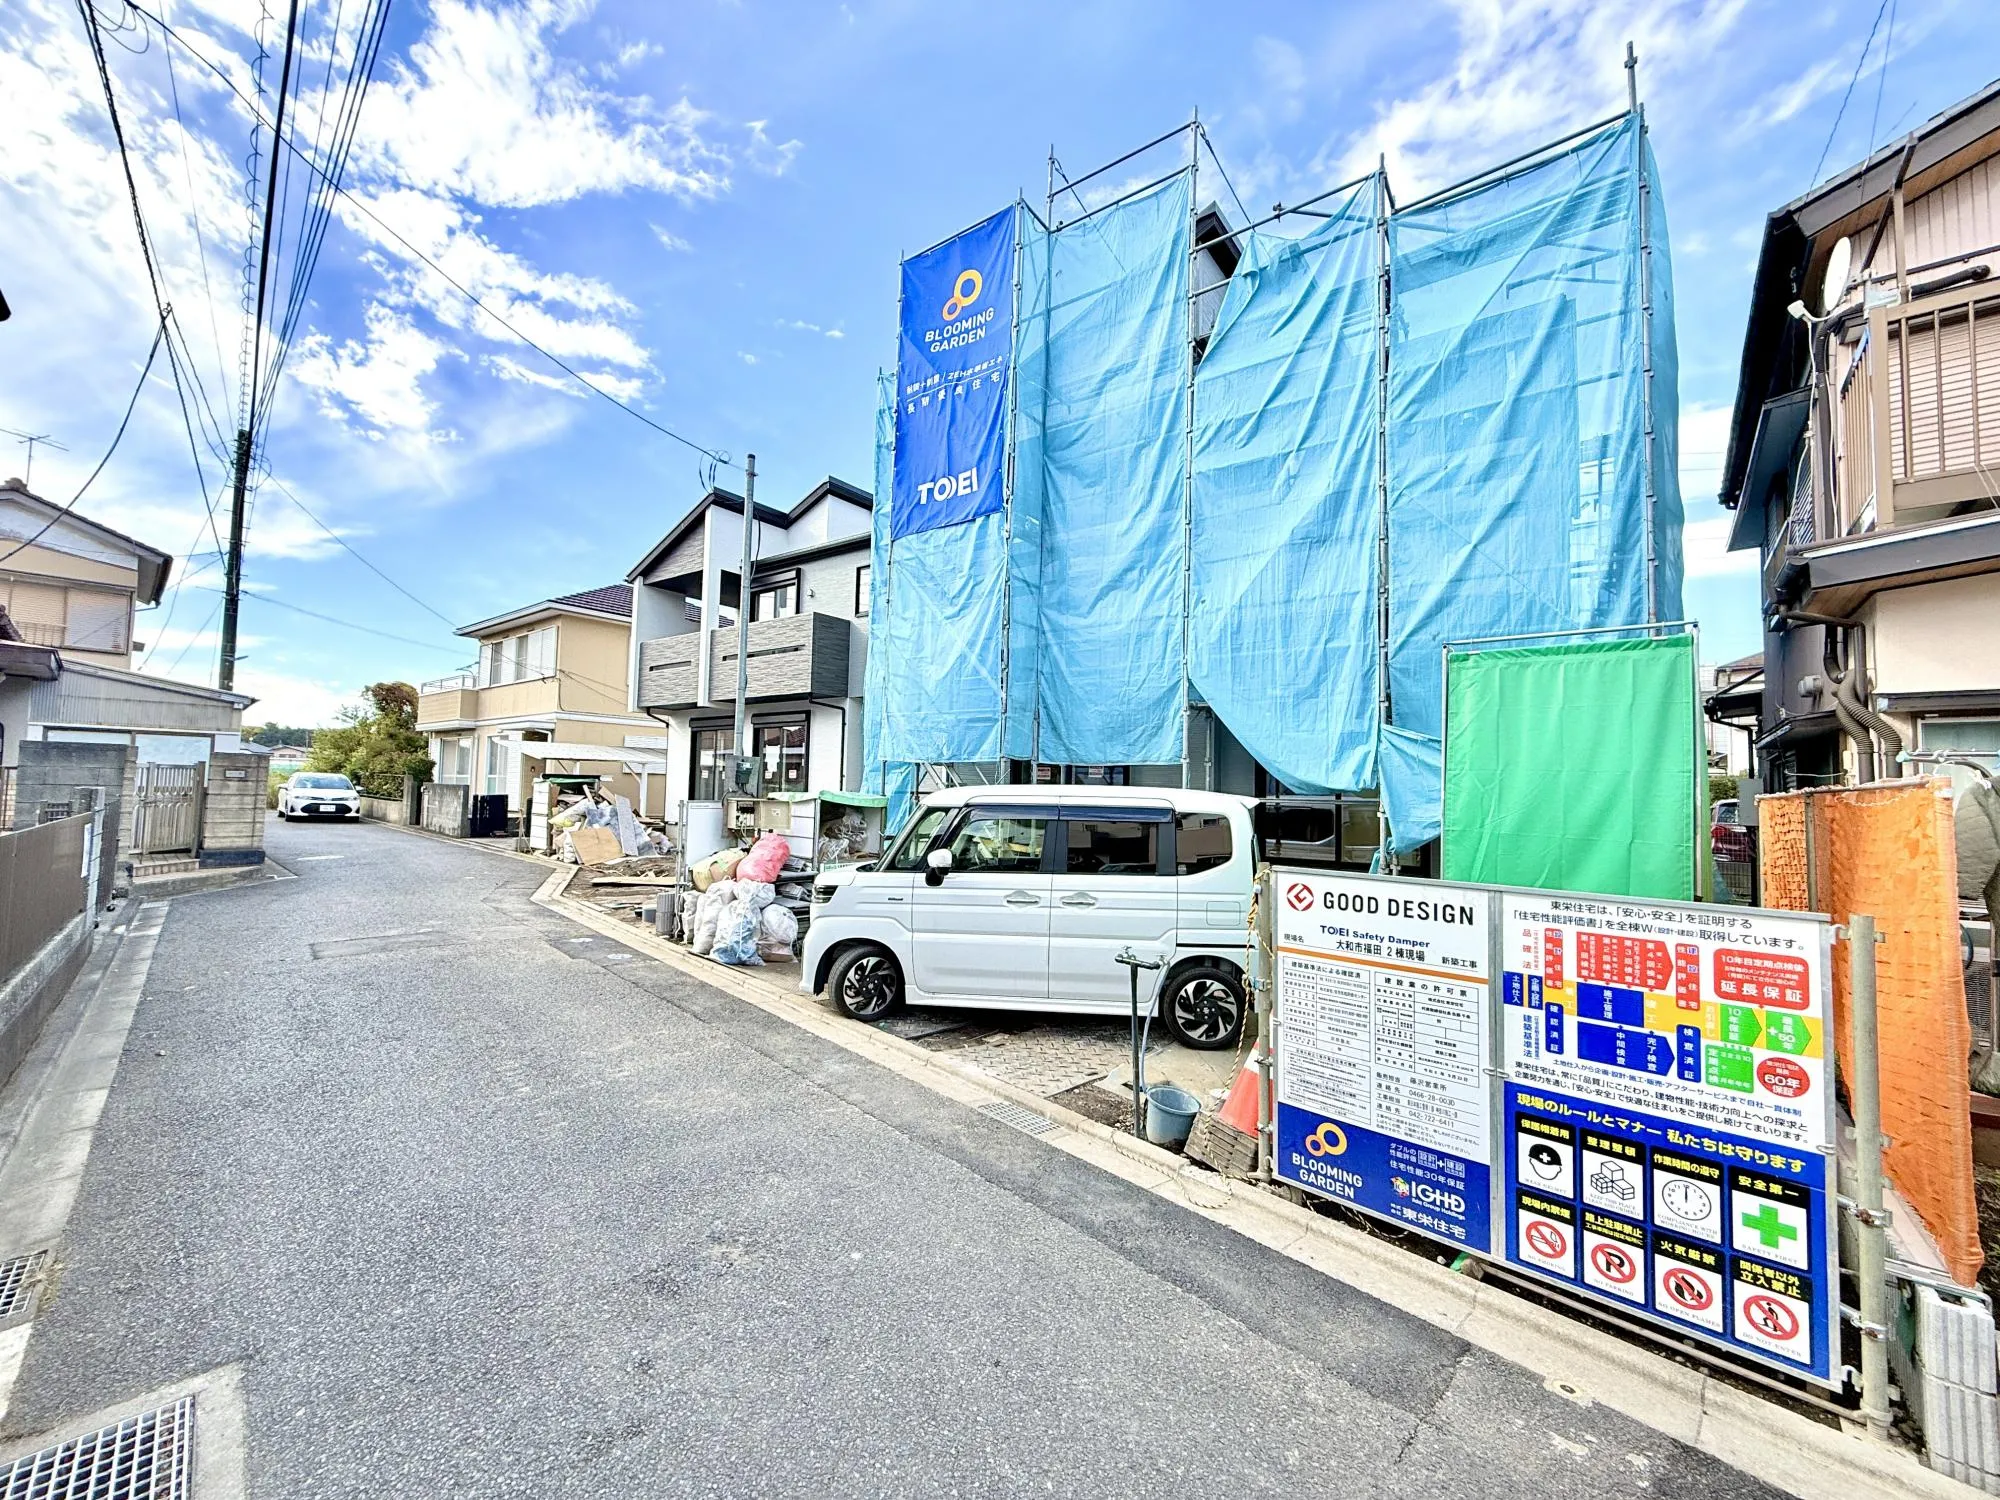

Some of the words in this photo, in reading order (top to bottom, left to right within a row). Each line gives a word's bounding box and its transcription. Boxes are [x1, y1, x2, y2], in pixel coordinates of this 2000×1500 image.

[925, 308, 994, 342] BLOOMING
[930, 328, 986, 352] GARDEN
[1323, 891, 1378, 914] GOOD
[1388, 898, 1473, 925] DESIGN
[1336, 938, 1381, 955] 大和市福田
[1441, 956, 1477, 969] 新築工事
[1352, 930, 1384, 943] Safety
[1388, 935, 1430, 949] Damper
[1522, 928, 1531, 969] 品確法
[1512, 974, 1520, 1003] 土地仕入
[1602, 988, 1612, 1019] 施工管理
[1720, 979, 1803, 1003] 延長保証
[1550, 1004, 1558, 1052] 確認済証
[1616, 1031, 1625, 1065] 中間検査
[1646, 1036, 1656, 1072] 完了検査
[1683, 1028, 1694, 1079] 検査済証
[1764, 1073, 1800, 1089] 60年
[1390, 1141, 1416, 1156] ダブルの
[1516, 1092, 1661, 1139] 現場のルールとマナー
[1667, 1128, 1806, 1175] 私たちは守ります
[1292, 1152, 1362, 1188] BLOOMING
[1299, 1167, 1353, 1199] GARDEN
[1390, 1159, 1464, 1191] 住宅性能30年保証
[1738, 1174, 1798, 1200] 安全第一
[1402, 1205, 1465, 1240] 東栄住宅
[1739, 1259, 1799, 1287] 関係者以外
[1740, 1269, 1800, 1298] 立入禁止
